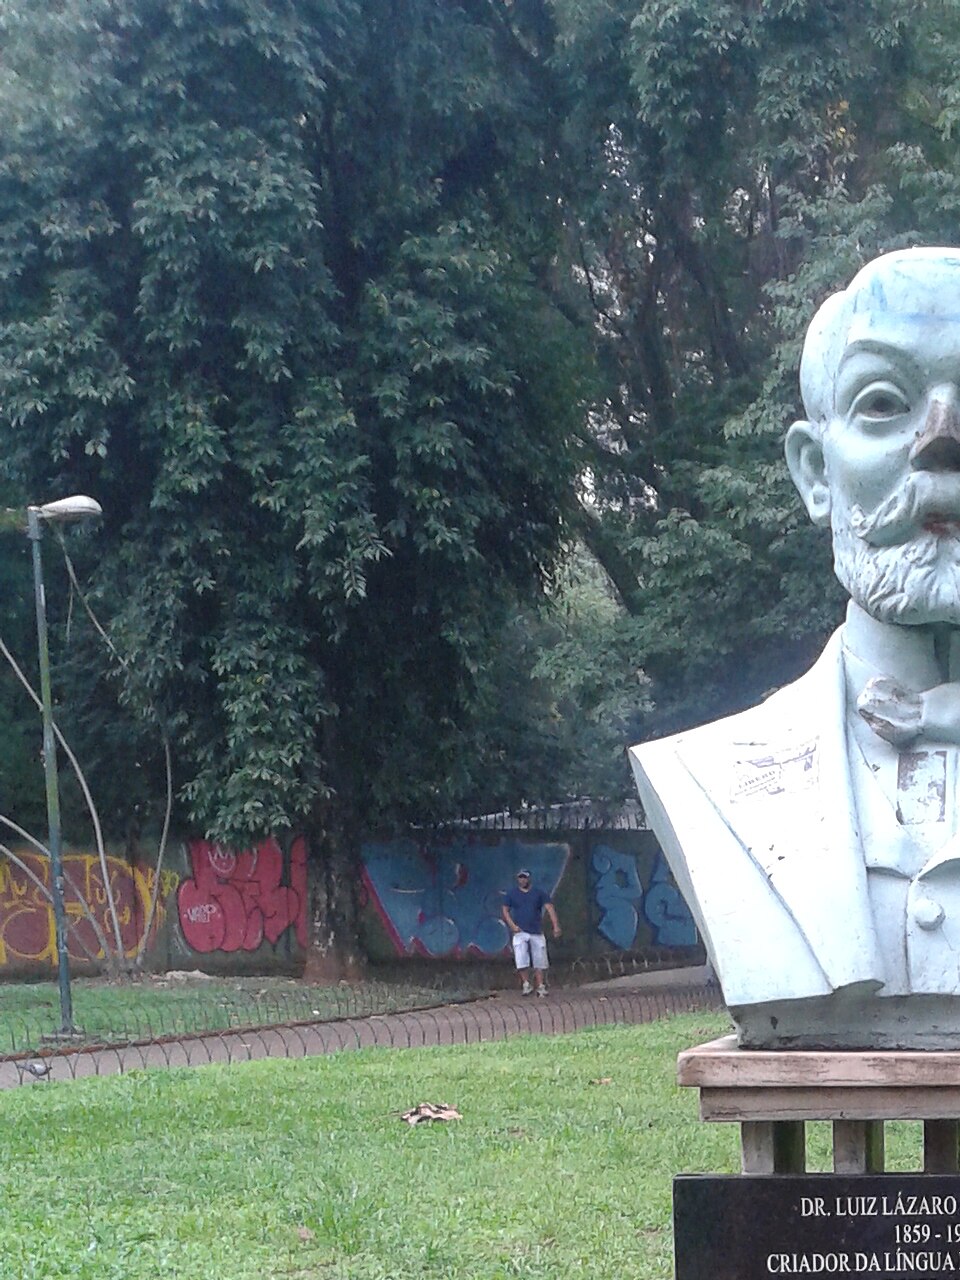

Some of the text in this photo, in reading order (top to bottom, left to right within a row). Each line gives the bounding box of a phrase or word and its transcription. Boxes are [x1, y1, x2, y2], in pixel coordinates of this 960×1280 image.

[800, 1197, 831, 1217] DR.
[836, 1196, 878, 1216] LUIZ
[881, 1191, 957, 1216] LÁZARO
[895, 1223, 931, 1244] 1859
[766, 1252, 852, 1273] CRIADOR
[854, 1252, 882, 1272] DA
[883, 1247, 956, 1272] LÍNGUA
